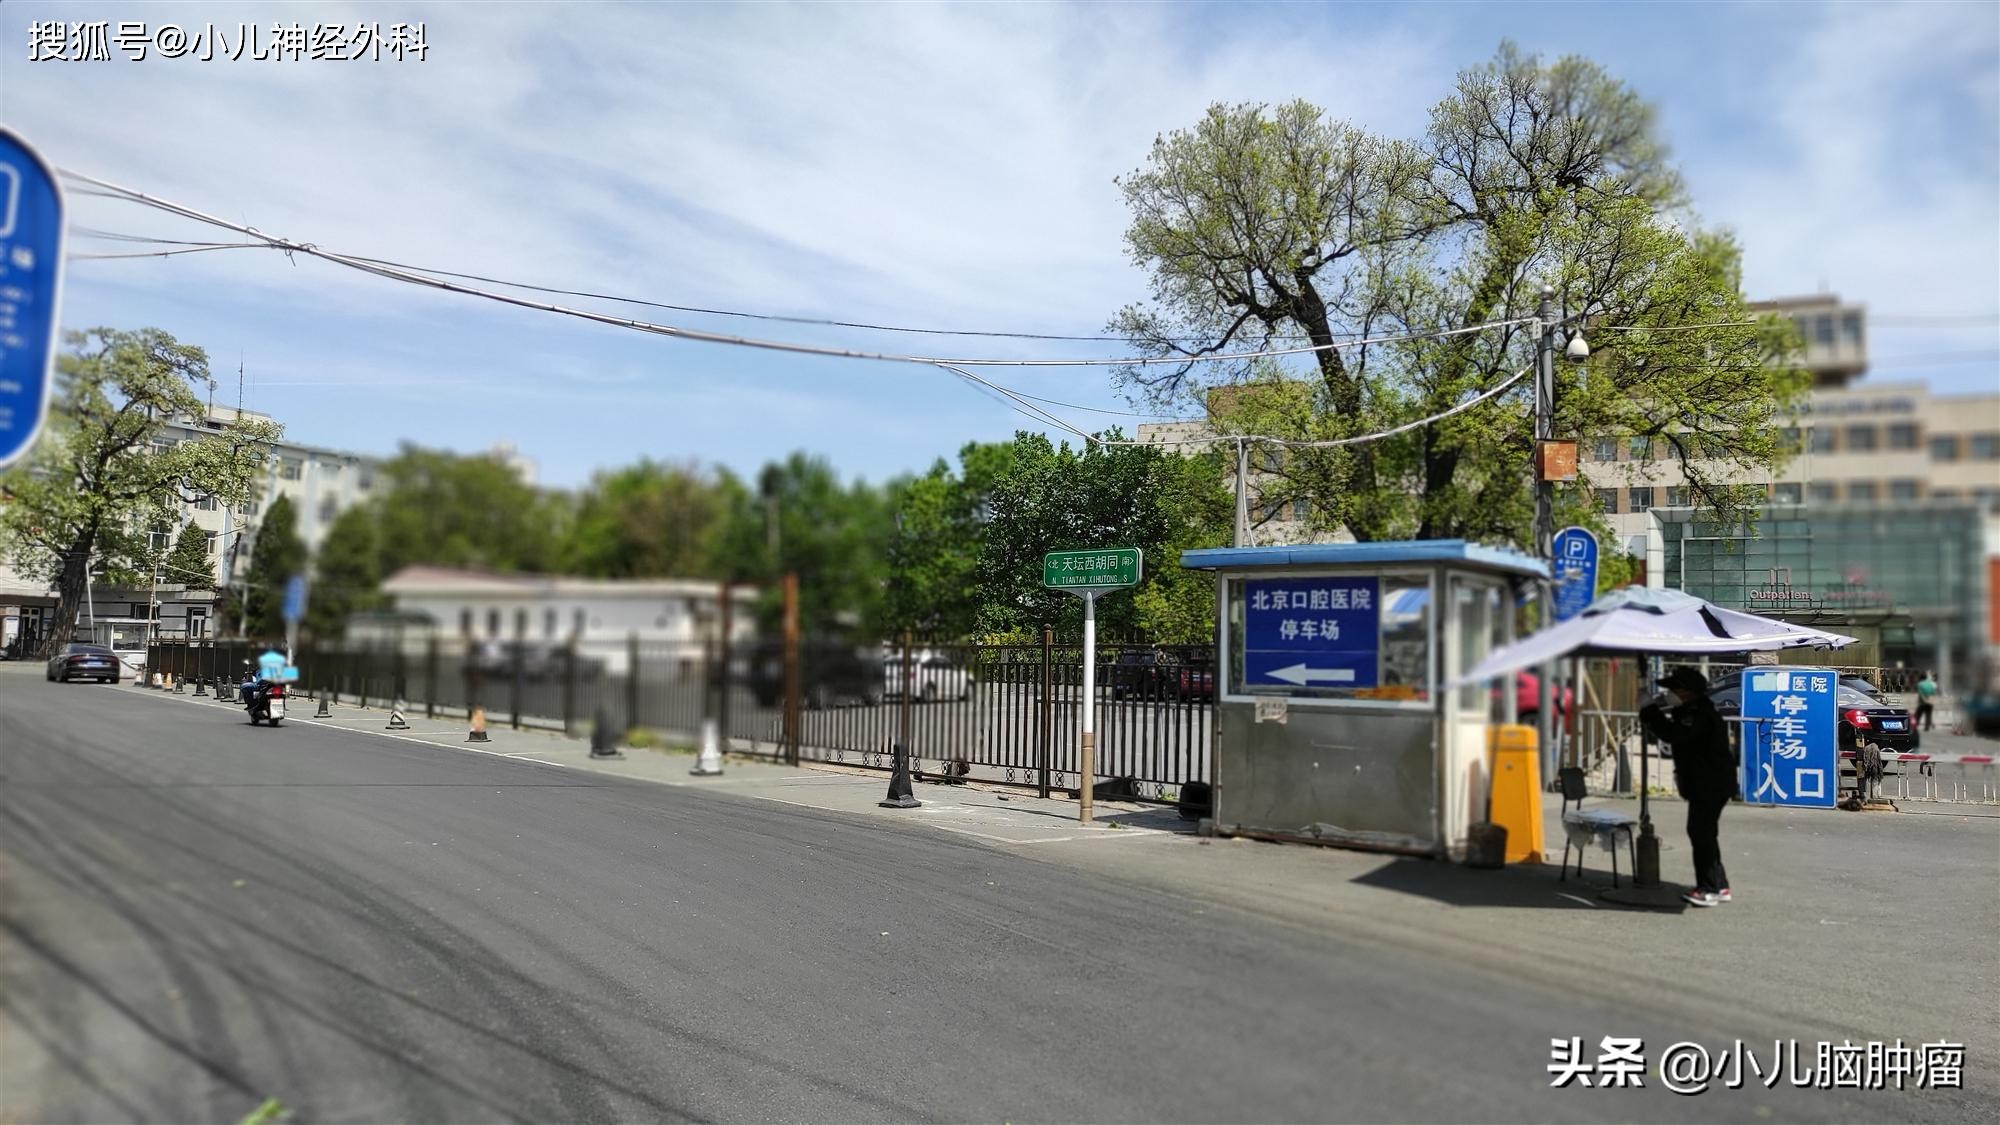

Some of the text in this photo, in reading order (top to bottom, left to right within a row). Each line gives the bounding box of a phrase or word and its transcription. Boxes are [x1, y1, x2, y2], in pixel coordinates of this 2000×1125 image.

[1051, 555, 1130, 571] 北 天坛西胡同 南
[1062, 576, 1086, 584] TIANTAN
[1088, 575, 1117, 583] XIHUTONG
[1123, 574, 1128, 583] S
[1251, 589, 1371, 610] 北京口腔医院
[1280, 619, 1340, 641] 停车场
[1771, 695, 1808, 760] 停车场
[1752, 762, 1824, 800] 入口
